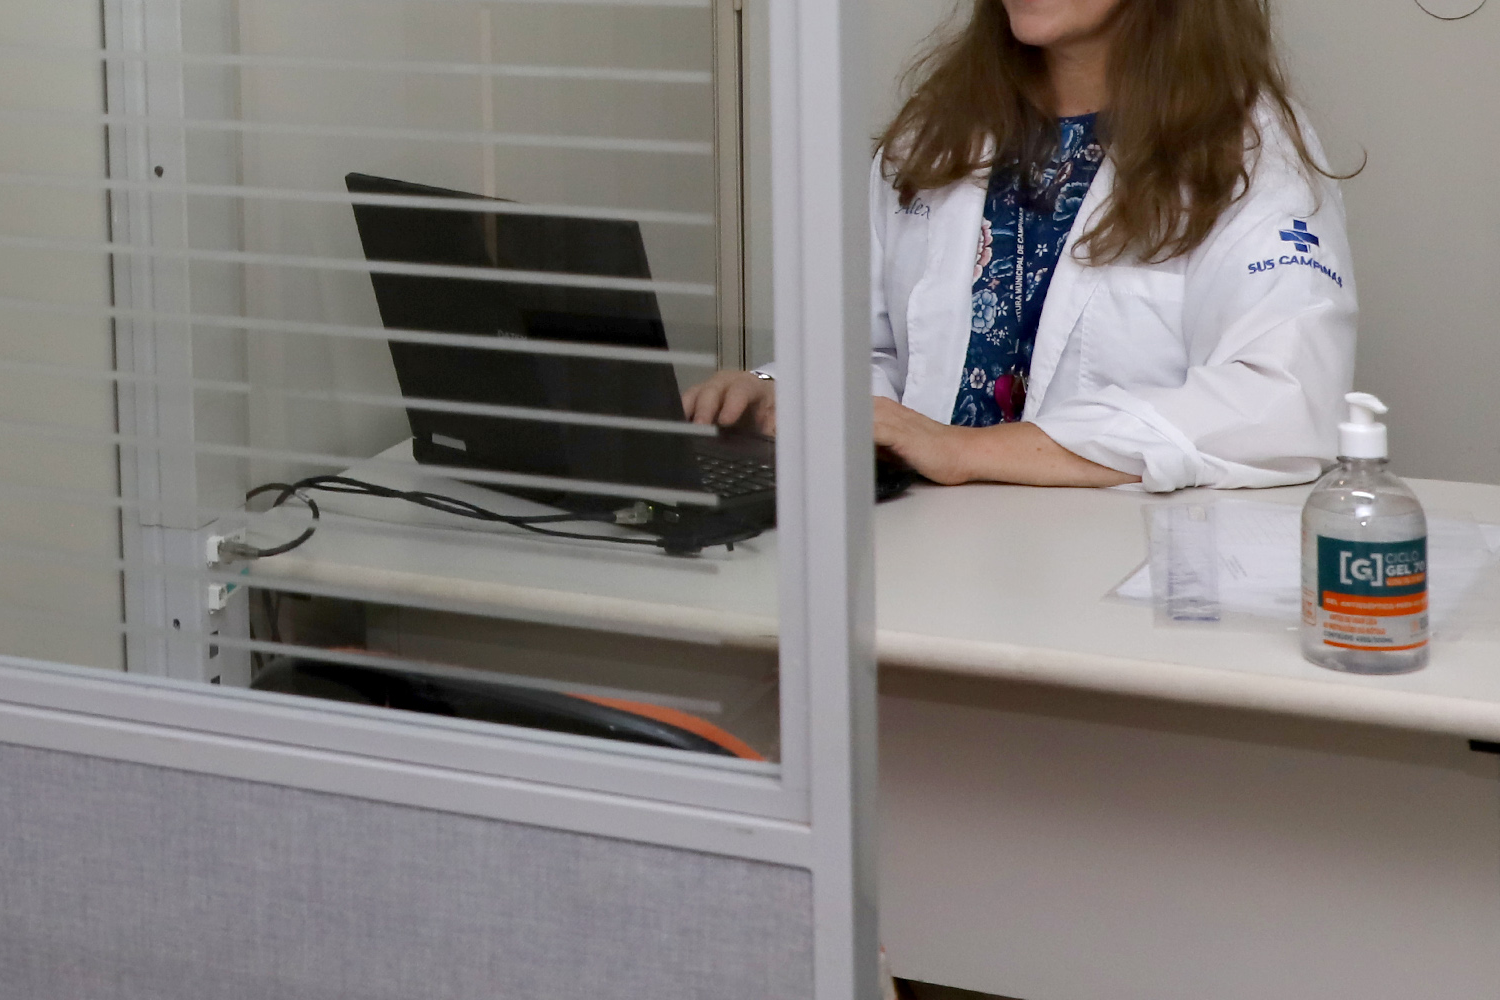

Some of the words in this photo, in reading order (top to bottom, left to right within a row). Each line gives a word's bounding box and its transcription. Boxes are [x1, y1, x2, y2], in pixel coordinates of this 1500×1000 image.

[1016, 243, 1024, 255] DE
[1014, 256, 1024, 294] MUNICIPAL
[1247, 258, 1276, 275] SUS
[1279, 255, 1343, 289] CAMPINAS
[1385, 564, 1412, 578] GEL
